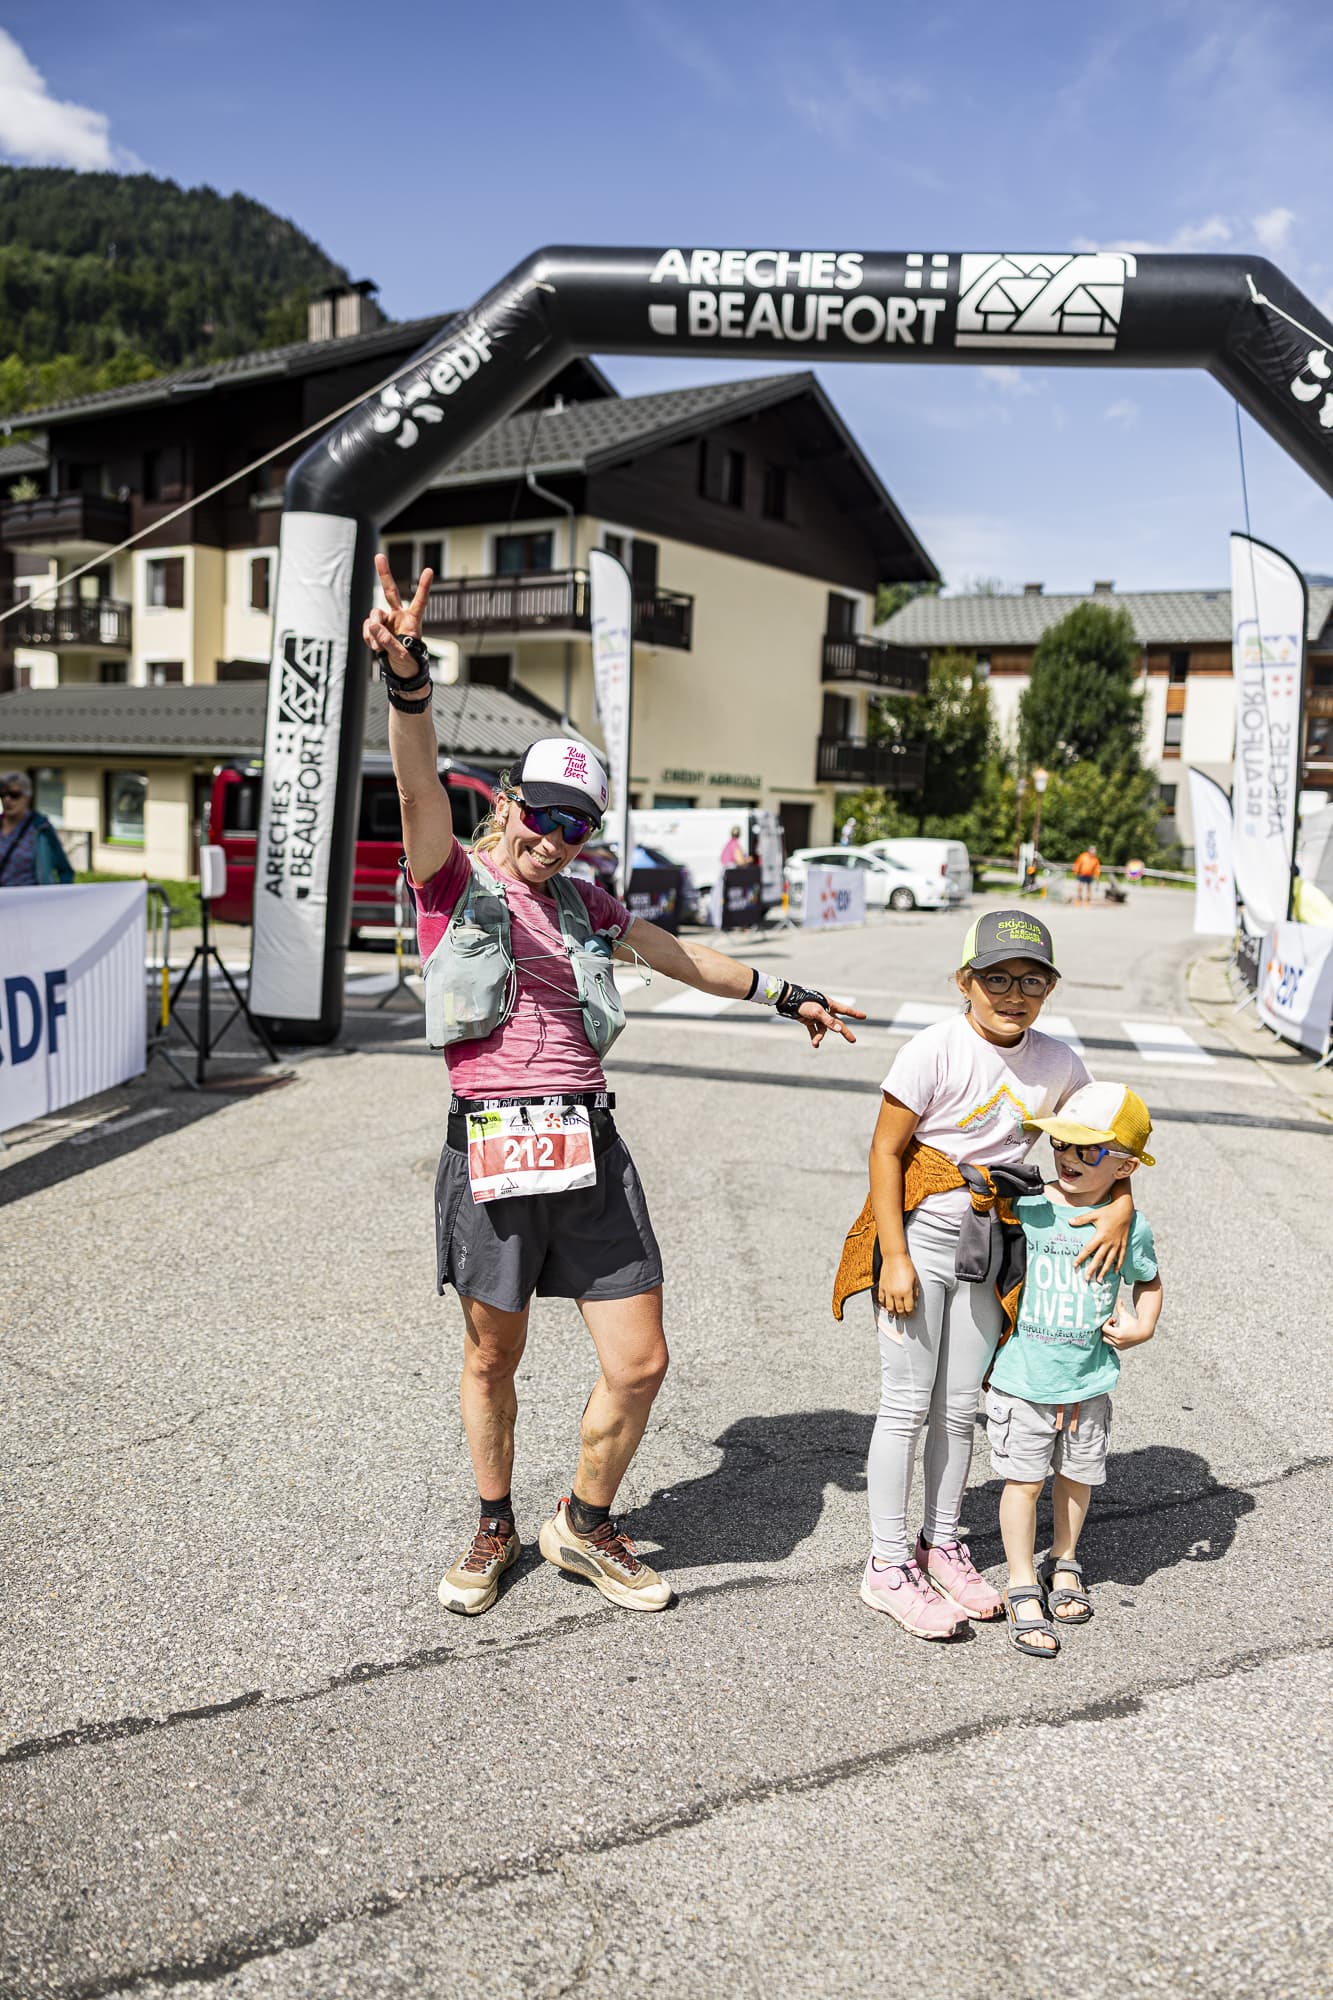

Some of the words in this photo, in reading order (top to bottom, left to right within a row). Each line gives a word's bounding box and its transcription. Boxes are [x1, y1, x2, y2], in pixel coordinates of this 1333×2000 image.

[648, 248, 865, 290] ARECHES
[687, 289, 947, 345] BEAUFORT
[563, 756, 588, 775] Trail
[566, 746, 586, 761] Run
[563, 767, 588, 784] Beer
[290, 736, 323, 877] BEAUFORT
[265, 781, 291, 898] ARECHES
[0, 968, 67, 1067] DF
[503, 1136, 555, 1170] 212
